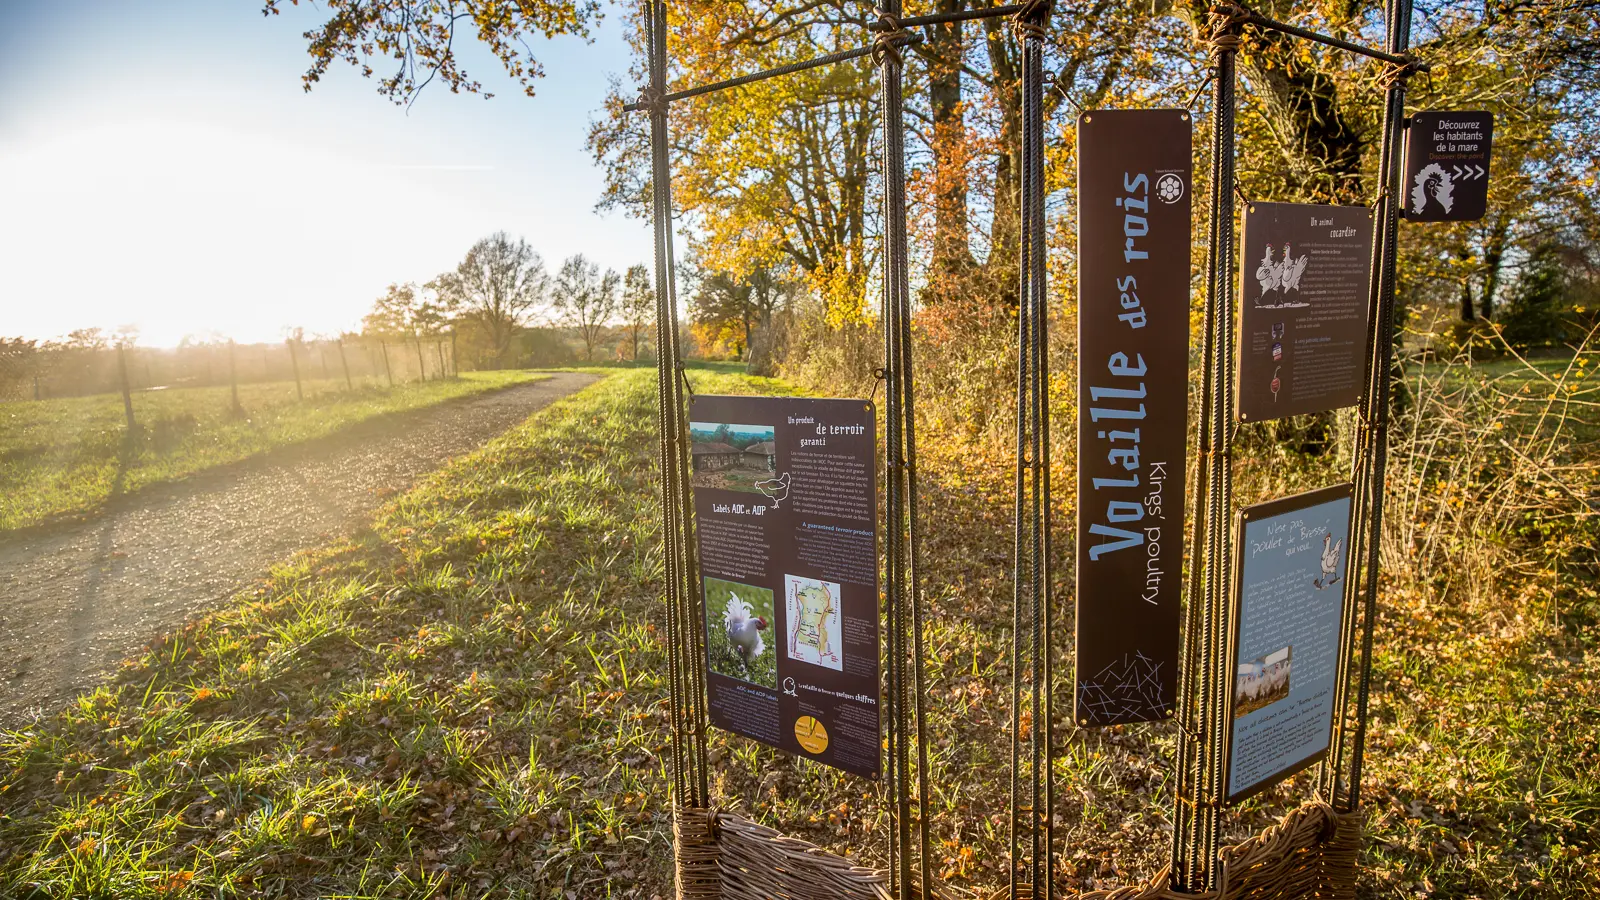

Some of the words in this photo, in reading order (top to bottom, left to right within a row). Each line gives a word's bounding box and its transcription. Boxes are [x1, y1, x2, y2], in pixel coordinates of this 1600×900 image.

[1438, 120, 1480, 130] Découvrez
[1433, 132, 1444, 141] les
[1446, 132, 1483, 141] habitants
[1436, 142, 1446, 152] de
[1448, 142, 1456, 152] la
[1458, 144, 1478, 152] mare
[1116, 172, 1149, 262] rois
[1310, 216, 1318, 226] Un
[1319, 218, 1334, 226] animal
[1330, 226, 1356, 238] cocardier
[1116, 275, 1148, 329] des
[788, 416, 795, 424] Un
[796, 416, 814, 426] produit
[816, 423, 826, 434] de
[830, 424, 864, 434] terroir
[800, 437, 826, 448] garanti
[1088, 351, 1148, 561] Volaille
[1144, 461, 1167, 520] Kings'
[713, 504, 730, 514] Labels
[732, 504, 744, 514] AOC
[752, 505, 766, 516] AOP
[807, 523, 834, 531] guaranteed
[1290, 520, 1304, 533] pas
[1287, 535, 1295, 544] de
[1286, 545, 1296, 557] qui
[1142, 526, 1164, 606] poultry
[836, 692, 854, 700] quelques
[855, 693, 876, 704] chiffres
